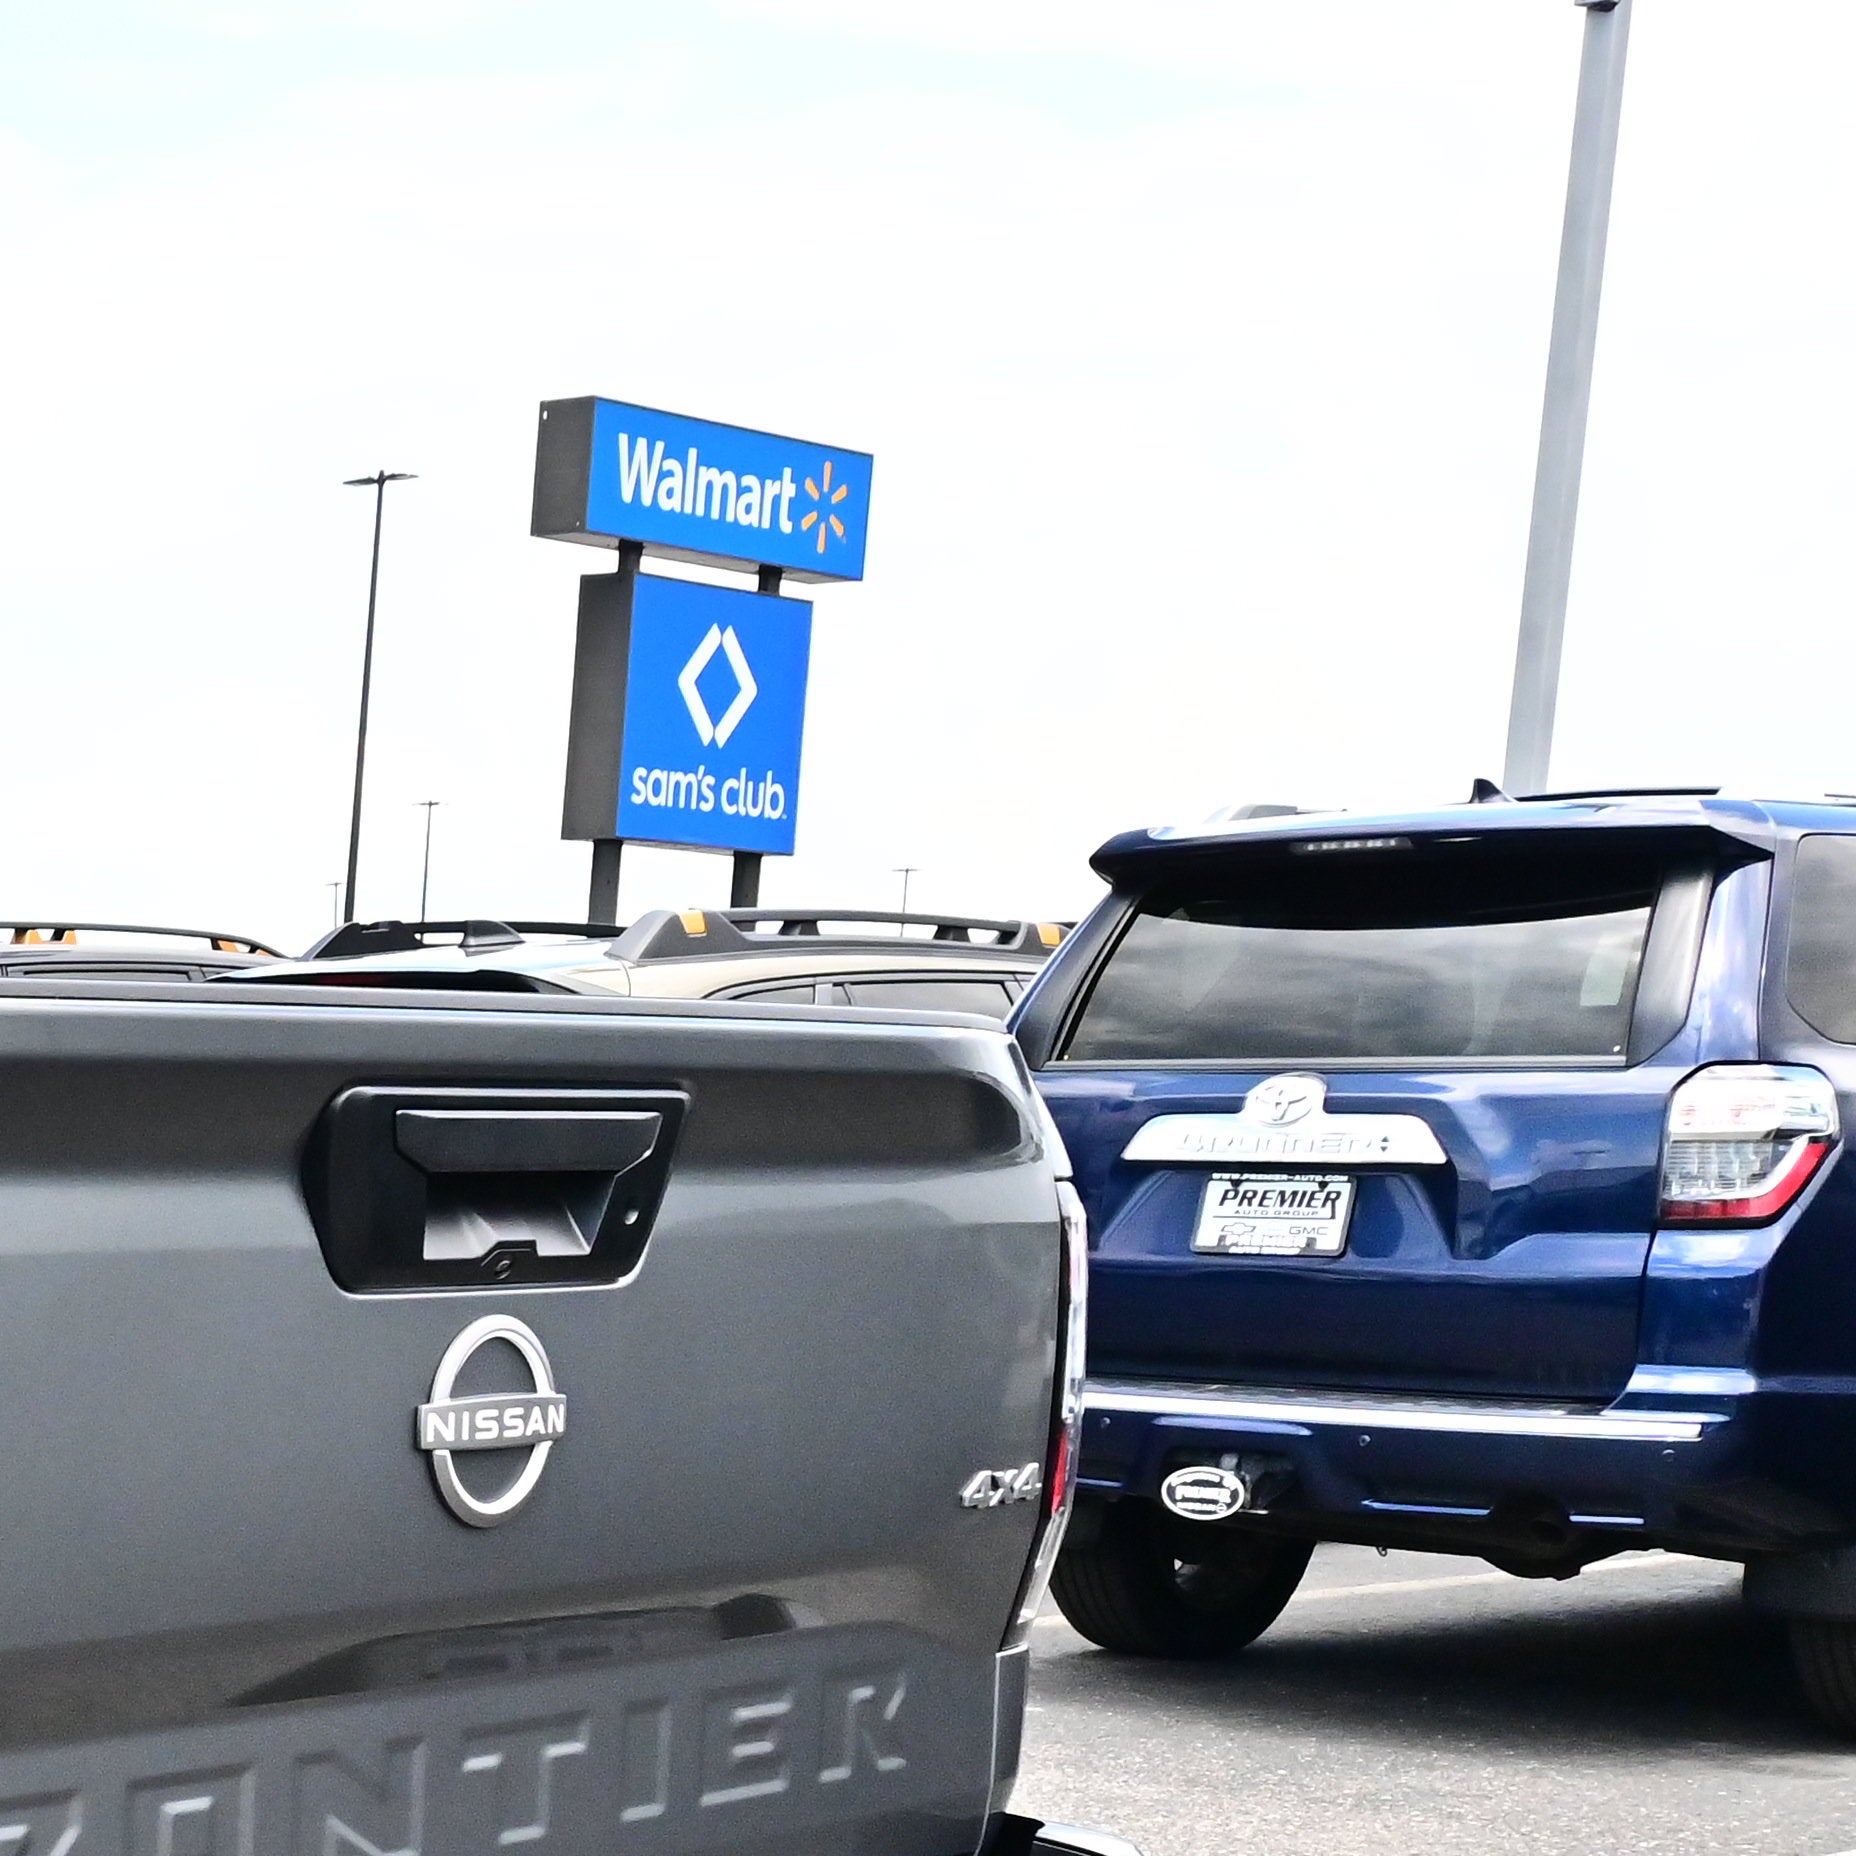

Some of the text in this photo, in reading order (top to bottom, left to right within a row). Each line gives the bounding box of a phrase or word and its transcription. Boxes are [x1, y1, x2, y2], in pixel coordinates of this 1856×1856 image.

[618, 432, 796, 534] Walmart
[630, 764, 785, 820] sam's club
[1218, 1188, 1343, 1212] PREMIER
[1273, 1209, 1319, 1217] GROUP
[1288, 1225, 1329, 1236] GMC
[425, 1403, 565, 1443] NISSAN
